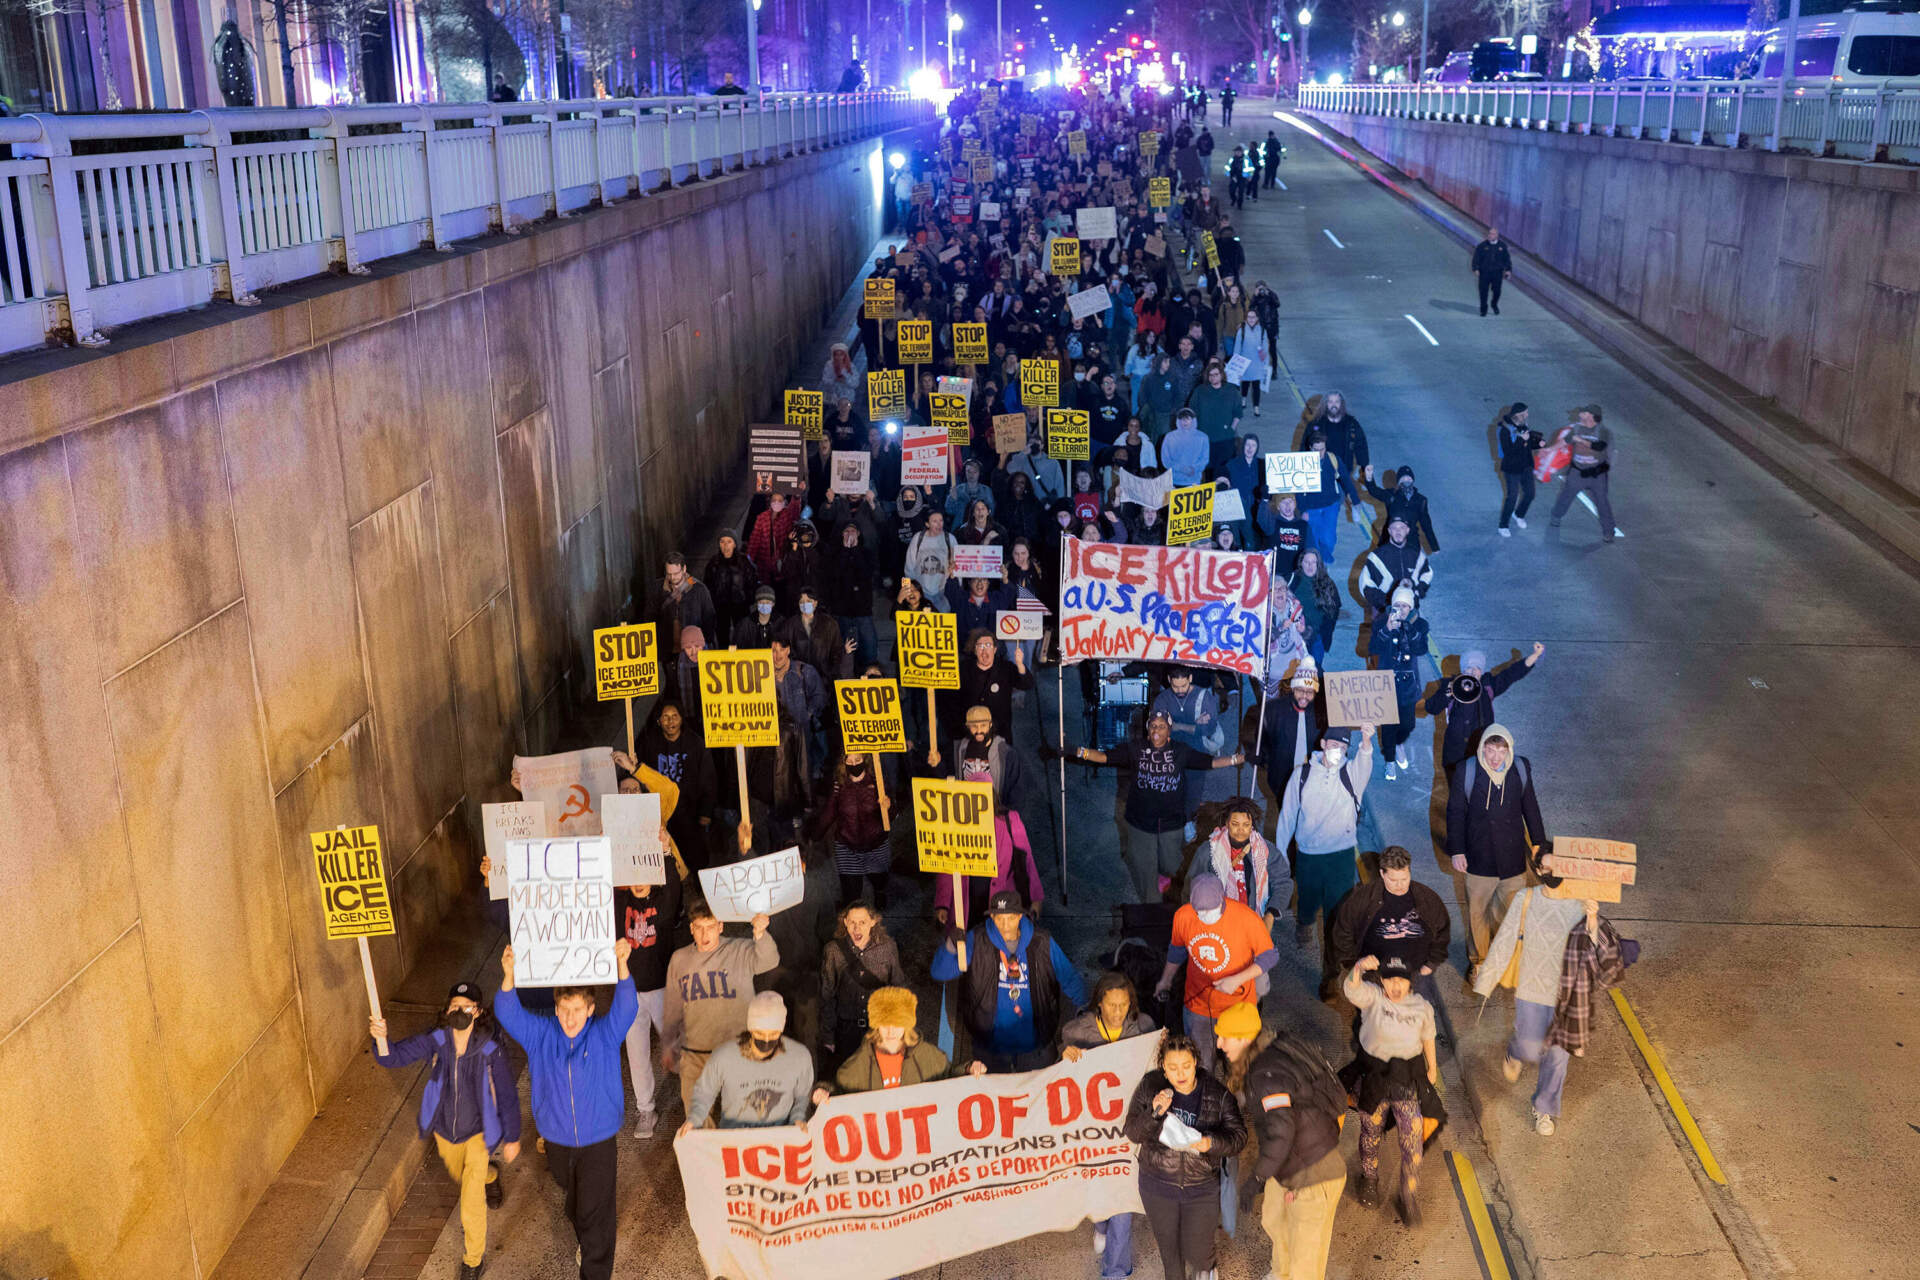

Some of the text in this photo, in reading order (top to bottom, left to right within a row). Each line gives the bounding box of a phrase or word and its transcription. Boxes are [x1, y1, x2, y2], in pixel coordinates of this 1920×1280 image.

[1053, 243, 1077, 256] STOP
[866, 281, 894, 291] DC
[901, 324, 929, 341] STOP
[956, 327, 984, 343] STOP
[1023, 361, 1056, 369] JAIL
[870, 372, 903, 381] JAIL
[1023, 369, 1057, 383] KILLER
[871, 380, 904, 395] KILLER
[1024, 384, 1057, 395] ICE
[789, 394, 821, 406] JUSTICE
[872, 395, 904, 408] ICE
[931, 396, 966, 409] DC
[788, 406, 819, 414] FOR
[933, 420, 968, 428] STOP
[1050, 412, 1087, 425] DC
[948, 429, 968, 438] ERROR
[1049, 425, 1088, 434] MINNEAPOLIS
[1050, 443, 1087, 453] ICE TERROR
[1267, 455, 1319, 472] ABOLISH
[1274, 470, 1318, 489] ICE
[1173, 488, 1212, 515] STOP
[1170, 513, 1211, 529] ICE TERROR
[1172, 524, 1208, 537] NOW
[1069, 538, 1149, 585] ICE
[900, 613, 953, 628] JAIL
[600, 630, 653, 662] STOP
[901, 627, 954, 650] KILLER
[903, 651, 956, 671] ICE
[598, 662, 655, 681] ICE TERROR
[705, 660, 769, 694] STOP
[904, 669, 957, 678] AGENTS
[602, 676, 653, 690] NOW
[1329, 675, 1392, 696] AMERICA
[841, 685, 896, 715] STOP
[706, 702, 774, 718] ICE TERROR
[1340, 696, 1384, 721] KILLS
[711, 721, 772, 731] NOW
[843, 718, 901, 733] ICE TERROR
[848, 733, 899, 743] NOW
[1140, 749, 1174, 763] ICE
[1139, 762, 1175, 773] KILLED
[920, 789, 989, 825] STOP
[316, 829, 376, 852] JAIL
[513, 840, 604, 882] ICE
[924, 849, 989, 860] NOW
[318, 849, 381, 883] KILLER
[714, 854, 801, 896] ABOLISH
[325, 882, 387, 912] ICE
[511, 883, 612, 910] MURDERED
[331, 909, 389, 922] AGENTS
[514, 911, 532, 943] A
[534, 909, 610, 943] WOMAN
[722, 1071, 1123, 1186] ICE OUT OF DC
[725, 1184, 798, 1204] STOP
[856, 1135, 1056, 1184] DEPORTATIONS
[1063, 1126, 1126, 1143] NOW
[727, 1201, 756, 1219] ICE
[760, 1198, 819, 1226] FUERA
[826, 1191, 852, 1212] DE
[898, 1183, 924, 1204] NO
[930, 1164, 970, 1195] MÁS
[977, 1142, 1131, 1180] DEPORTACIONES
[765, 1234, 791, 1248] FOR
[795, 1222, 866, 1243] SOCIALISM
[882, 1199, 953, 1231] LIBERATION
[962, 1181, 1048, 1204] WASHINGTON
